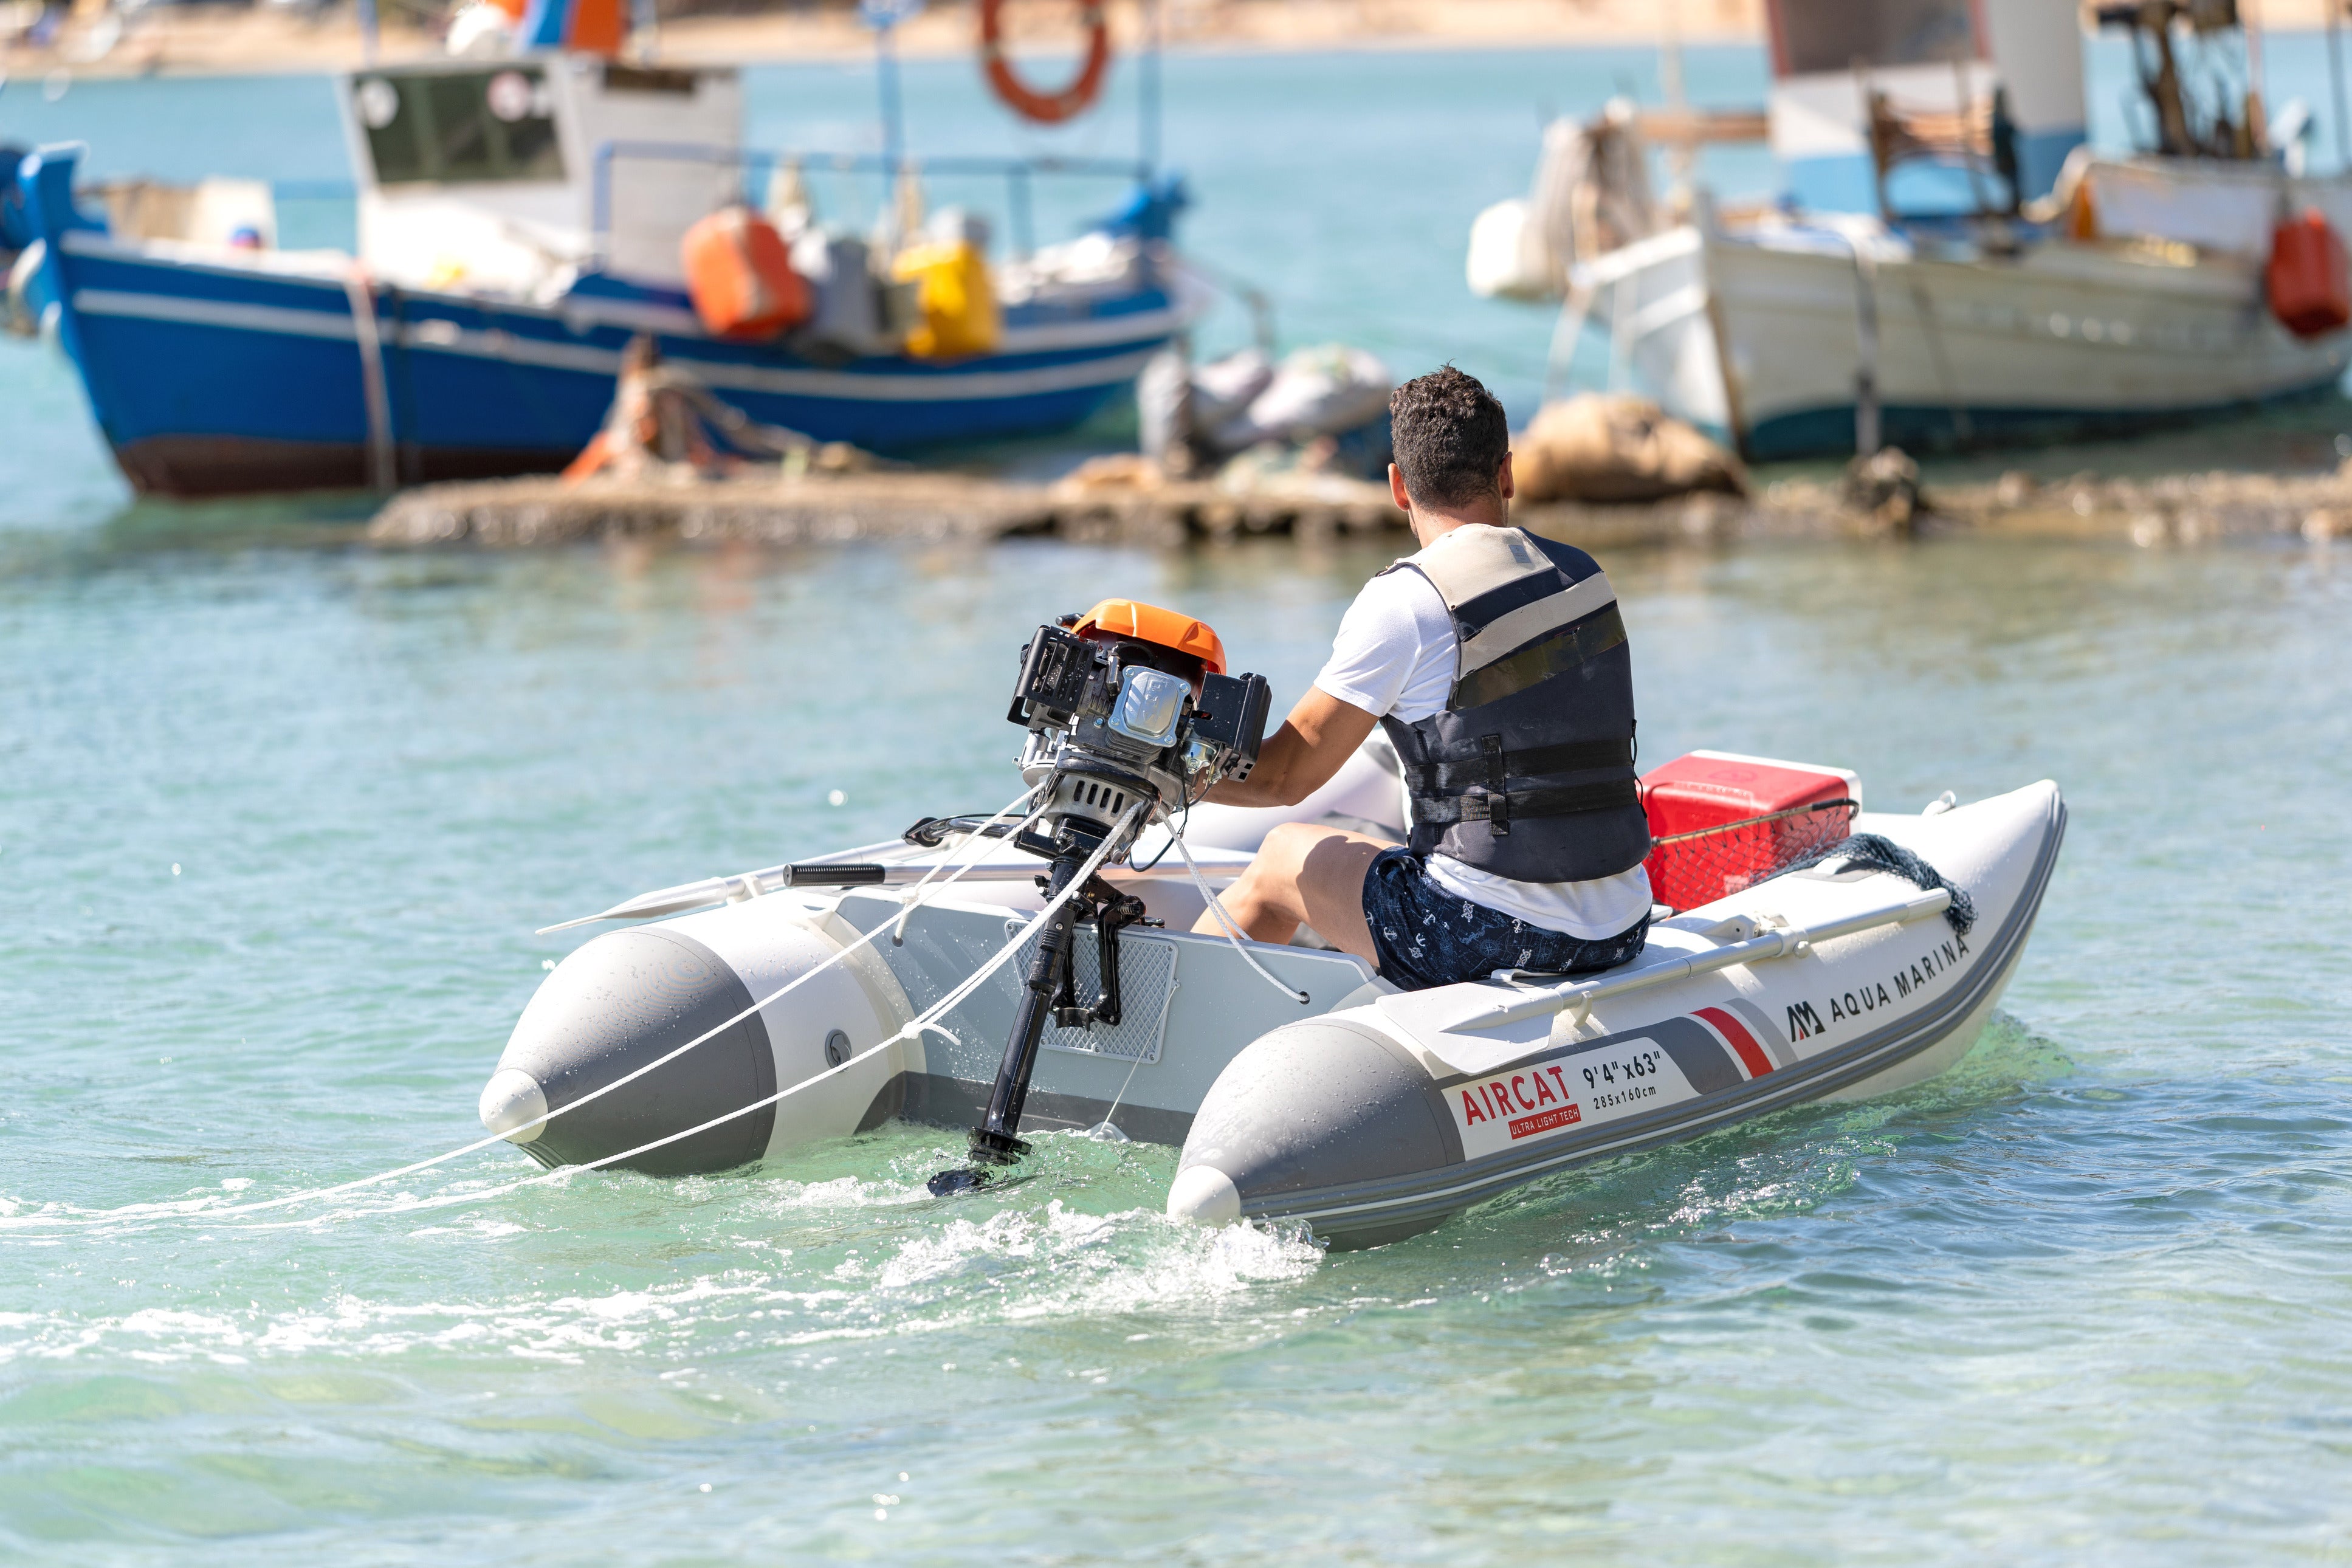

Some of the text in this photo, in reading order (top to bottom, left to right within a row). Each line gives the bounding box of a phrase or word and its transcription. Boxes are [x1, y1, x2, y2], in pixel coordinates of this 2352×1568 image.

[1830, 983, 1891, 1022] AQUA
[1893, 934, 1970, 998] MARINA
[1462, 1065, 1570, 1126] AIRCAT
[1594, 1086, 1656, 1110] 285x160cm
[1511, 1108, 1579, 1135] ULTRA LIGHT TECH
